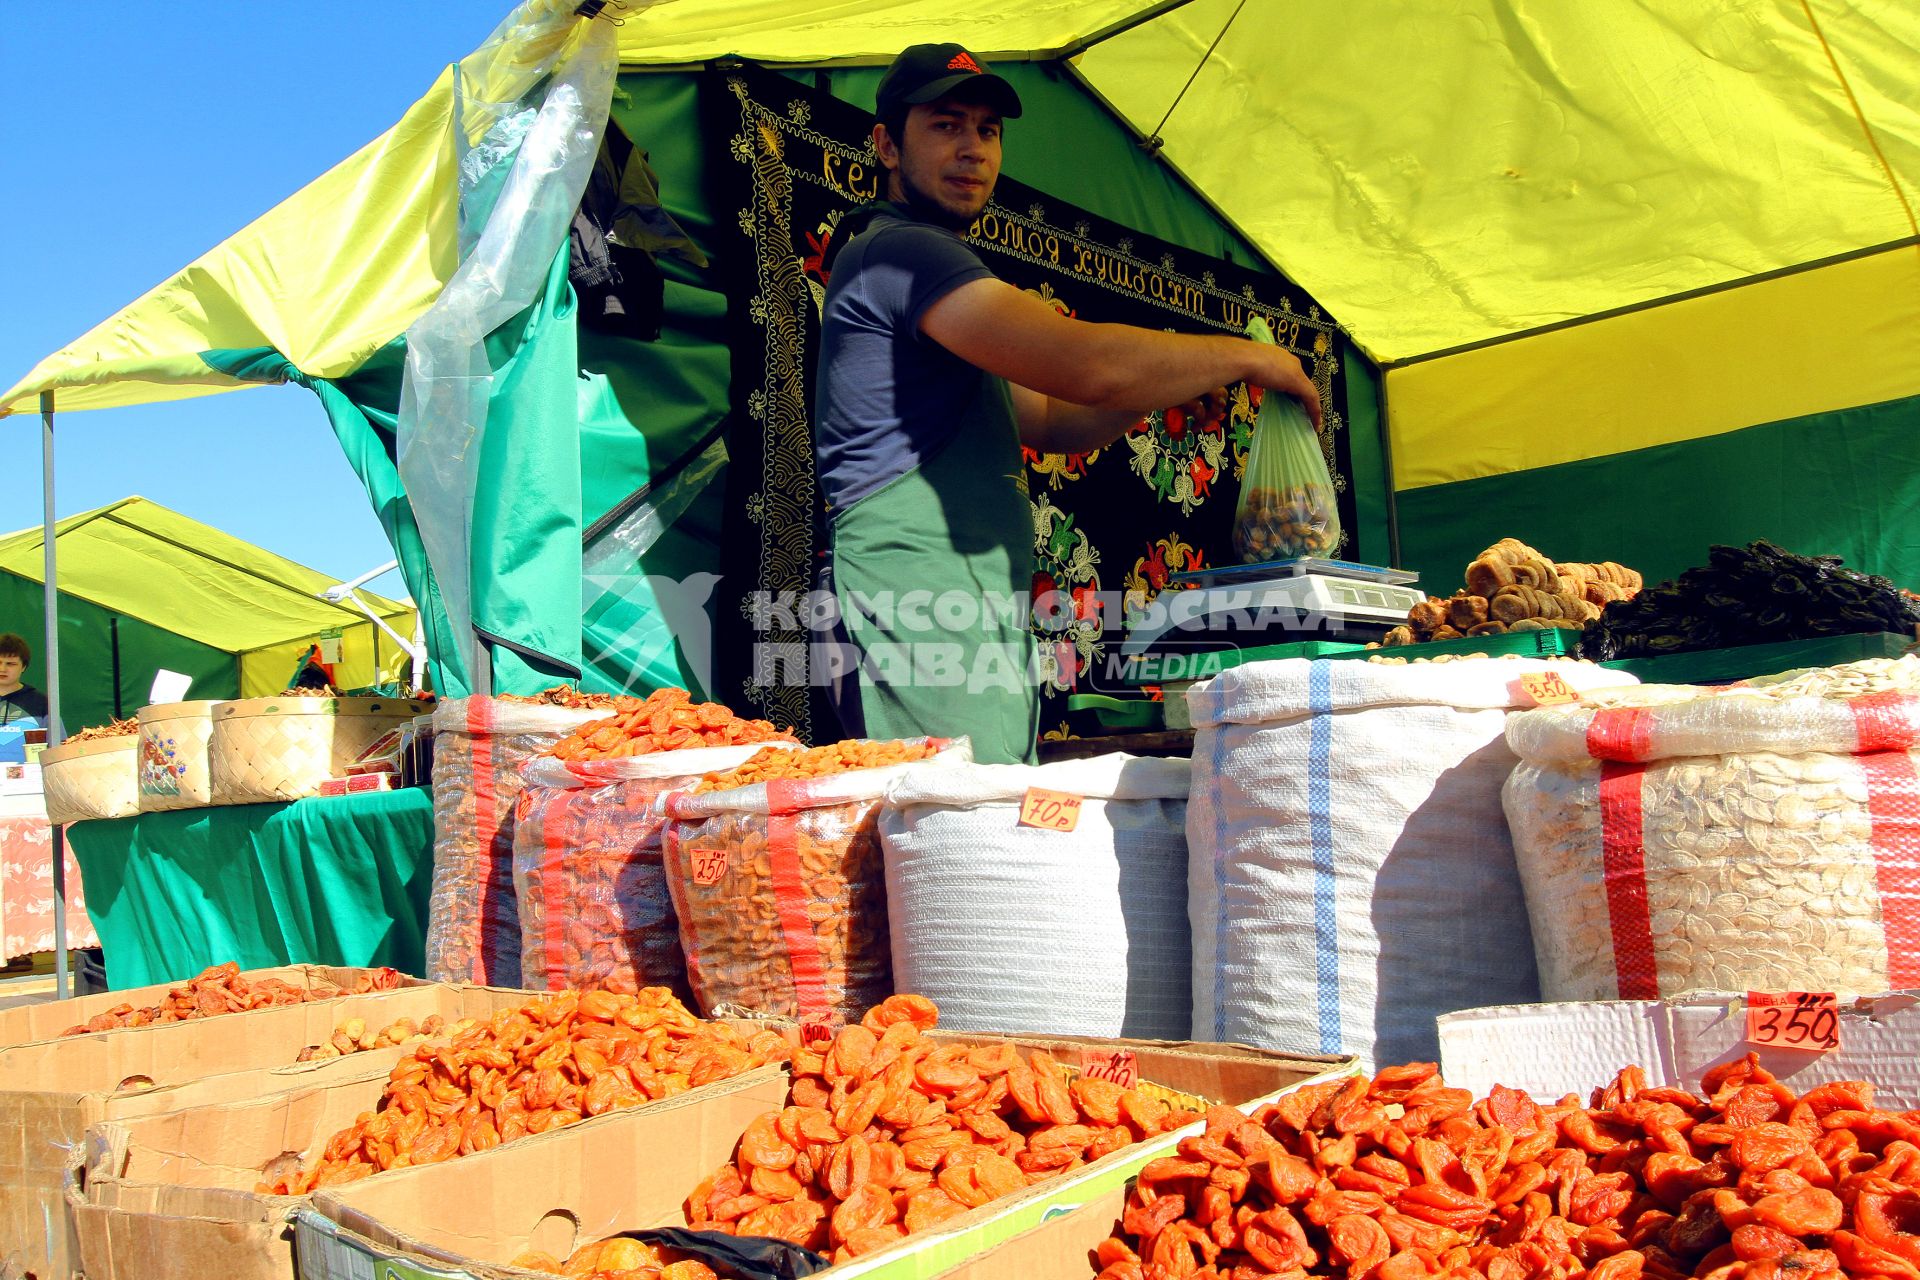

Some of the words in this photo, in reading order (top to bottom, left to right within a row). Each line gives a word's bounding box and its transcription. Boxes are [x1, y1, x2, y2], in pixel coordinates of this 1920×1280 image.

[1529, 680, 1567, 698] 350
[1028, 799, 1061, 822] 70
[697, 858, 725, 880] 250
[1755, 996, 1787, 1006] ЦЕНА
[1756, 1007, 1837, 1043] 350
